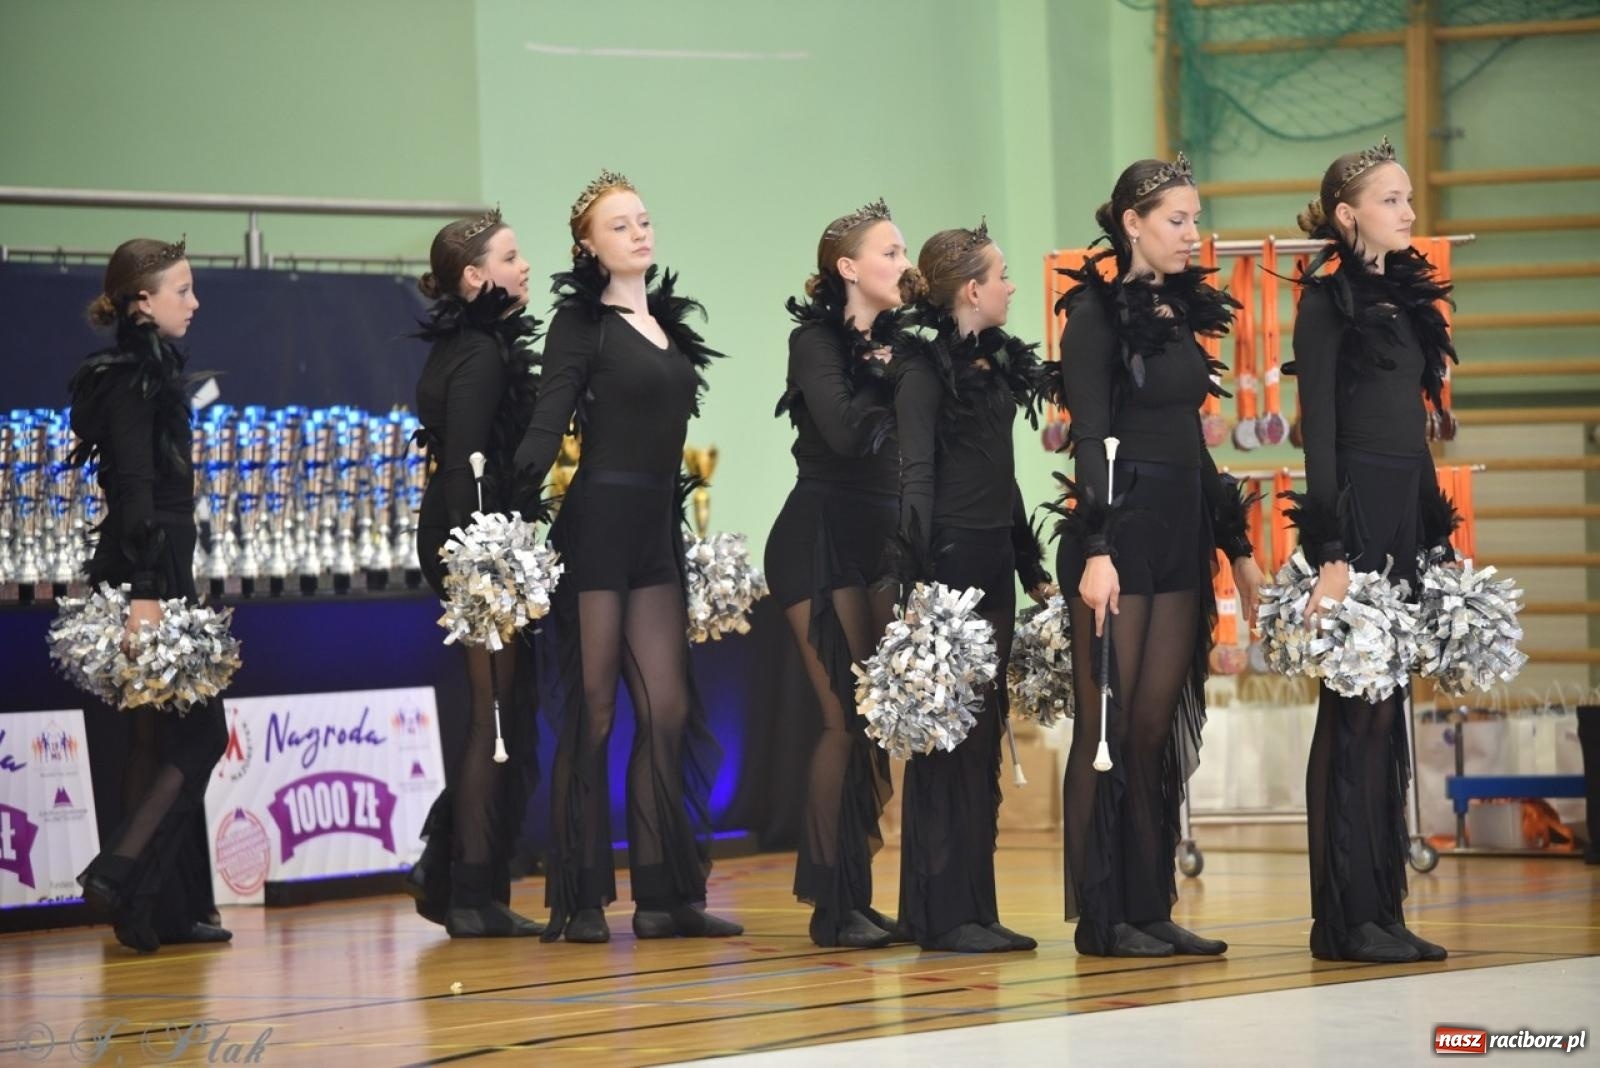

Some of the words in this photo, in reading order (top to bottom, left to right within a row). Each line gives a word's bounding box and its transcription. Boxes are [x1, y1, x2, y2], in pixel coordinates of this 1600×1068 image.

[265, 707, 387, 769] Nagroda
[283, 780, 350, 835] 1000
[353, 781, 381, 829] ZŁ
